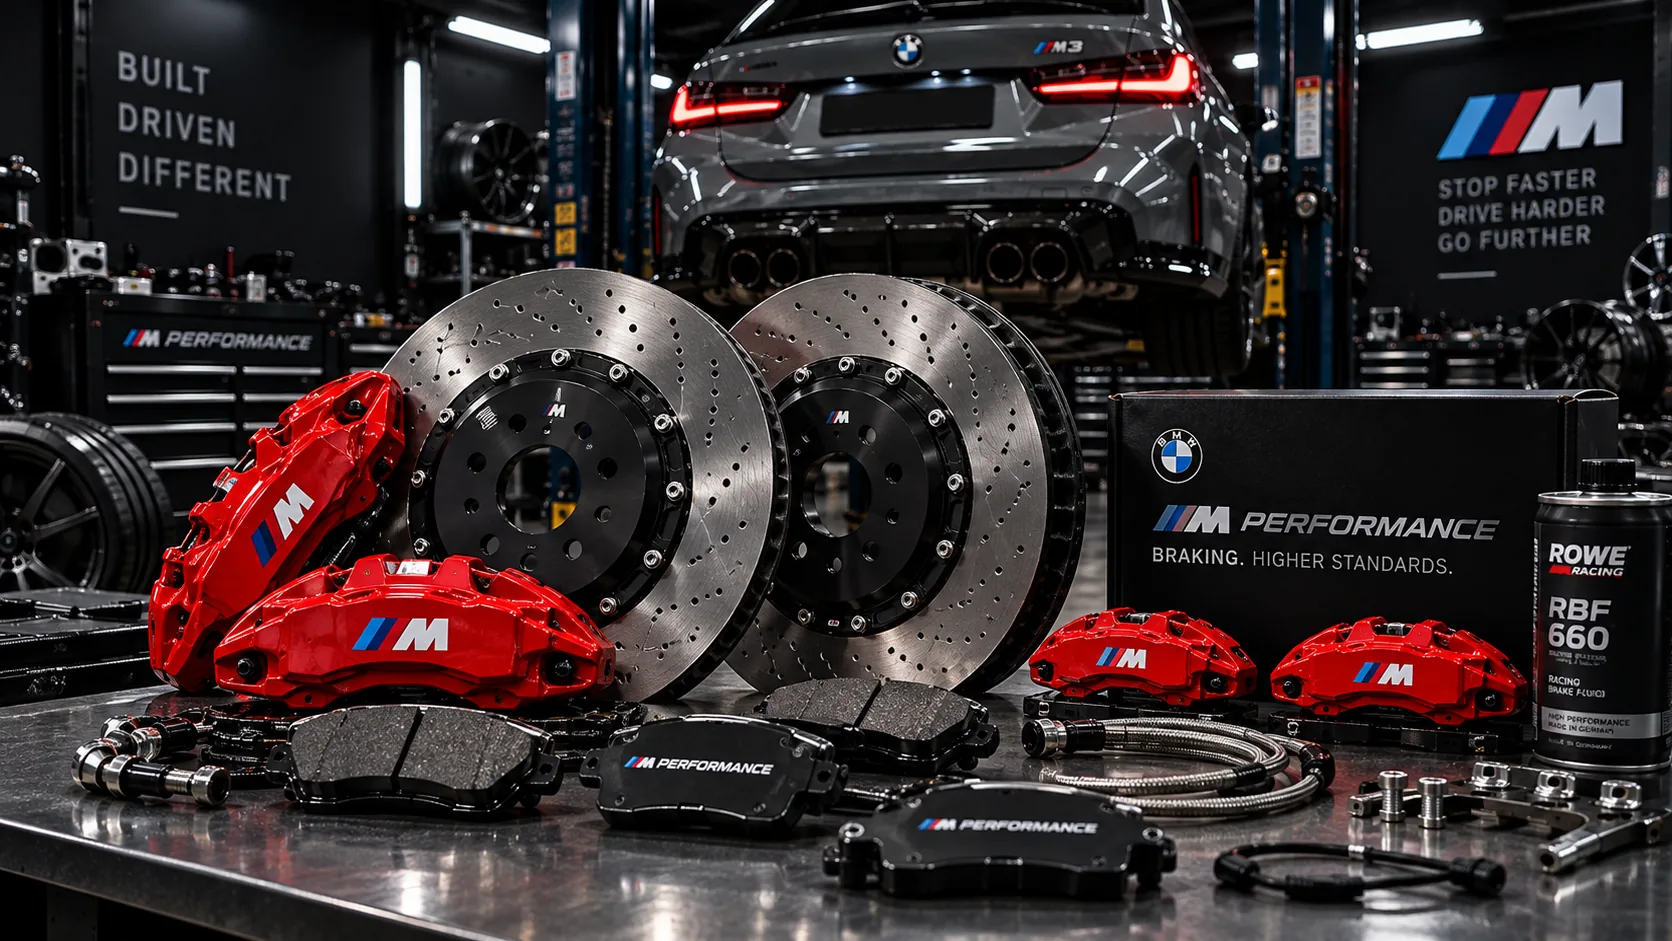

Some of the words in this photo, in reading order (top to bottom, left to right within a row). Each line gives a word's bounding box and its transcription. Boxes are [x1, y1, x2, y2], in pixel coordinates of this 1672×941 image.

[1050, 40, 1084, 53] M3
[118, 50, 211, 96] BUILT
[118, 101, 236, 149] DRIVEN
[1516, 79, 1624, 154] M
[118, 151, 292, 202] DIFFERENT
[1438, 175, 1499, 200] STOP
[1506, 167, 1597, 195] FASTER
[1438, 202, 1504, 227] DRIVE
[1511, 195, 1606, 221] HARDER
[1437, 231, 1471, 253] GO
[1479, 224, 1592, 251] FURTHER
[164, 330, 313, 351] PERFORMANCE
[1183, 505, 1230, 534] M
[1240, 511, 1500, 541] PERFORMANCE
[1152, 546, 1244, 566] BRAKING.
[1253, 550, 1325, 569] HIGHER
[1332, 553, 1453, 575] STANDARDS.
[1549, 543, 1628, 566] ROWE
[1571, 566, 1625, 576] RACING
[1548, 596, 1612, 622] RBF
[391, 618, 449, 651] M
[1548, 622, 1609, 651] 660
[1116, 648, 1147, 669] M
[1377, 663, 1414, 687] M
[656, 758, 775, 775] PERFORMANCE
[959, 819, 1098, 834] PERFORMANCE
